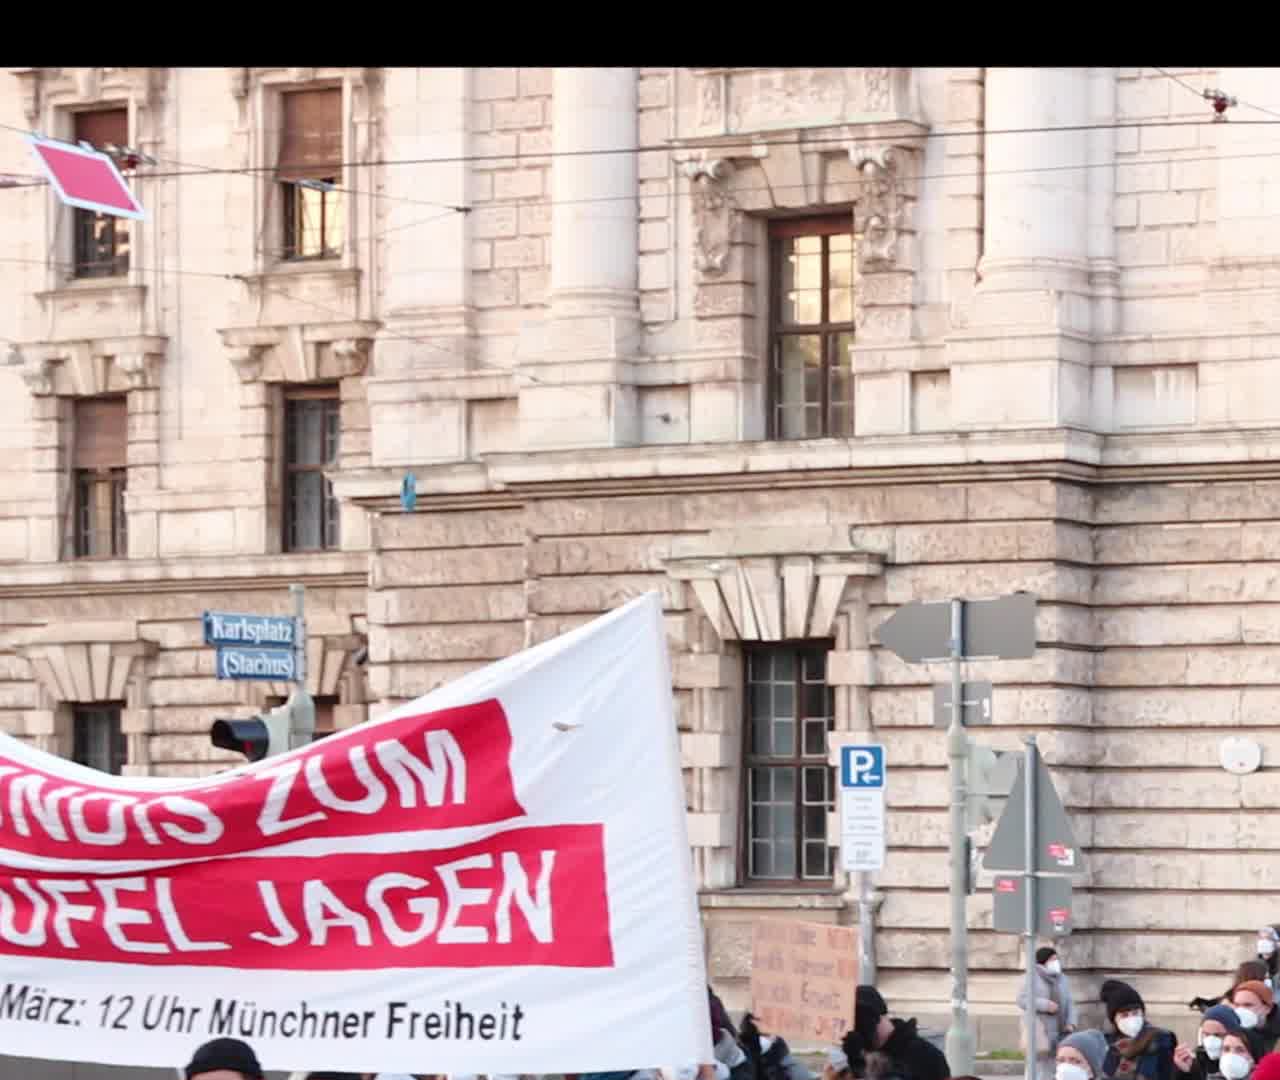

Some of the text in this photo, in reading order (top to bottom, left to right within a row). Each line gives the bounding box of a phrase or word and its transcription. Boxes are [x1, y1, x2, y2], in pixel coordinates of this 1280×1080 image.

[212, 615, 293, 644] Karlsplatz
[223, 651, 295, 678] (Stachus)
[256, 729, 467, 836] ZUM
[850, 750, 875, 784] P
[249, 850, 556, 947] JAGEN
[0, 983, 524, 1040] März: 12 Uhr Münchner Freiheit
